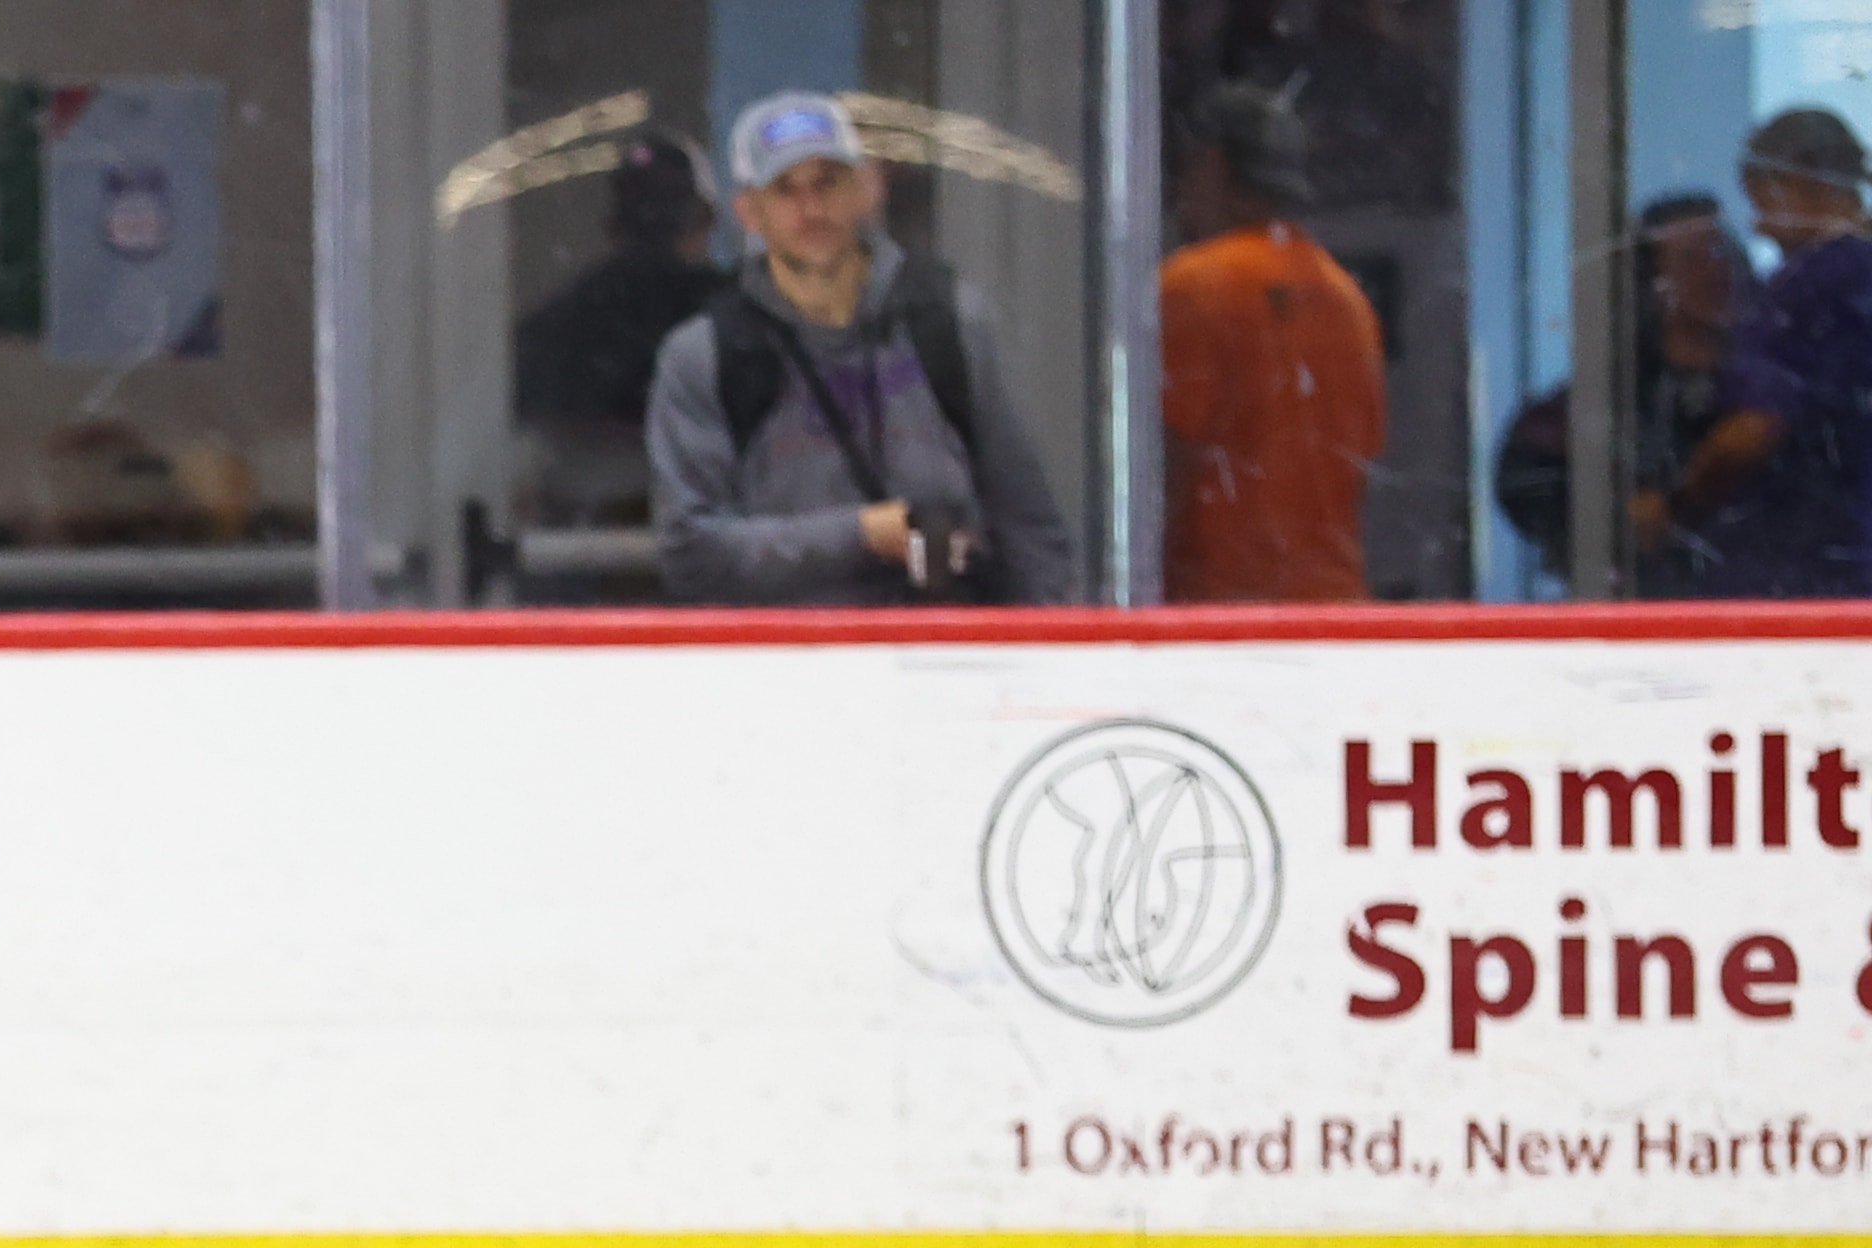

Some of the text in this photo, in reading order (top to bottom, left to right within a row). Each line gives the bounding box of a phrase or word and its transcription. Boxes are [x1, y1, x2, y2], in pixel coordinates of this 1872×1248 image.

[1342, 729, 1862, 852] Hamilt
[1345, 896, 1801, 1055] Spine
[1012, 1120, 1028, 1169] 1
[1064, 1115, 1294, 1173] Oxford
[1465, 1120, 1611, 1173] New
